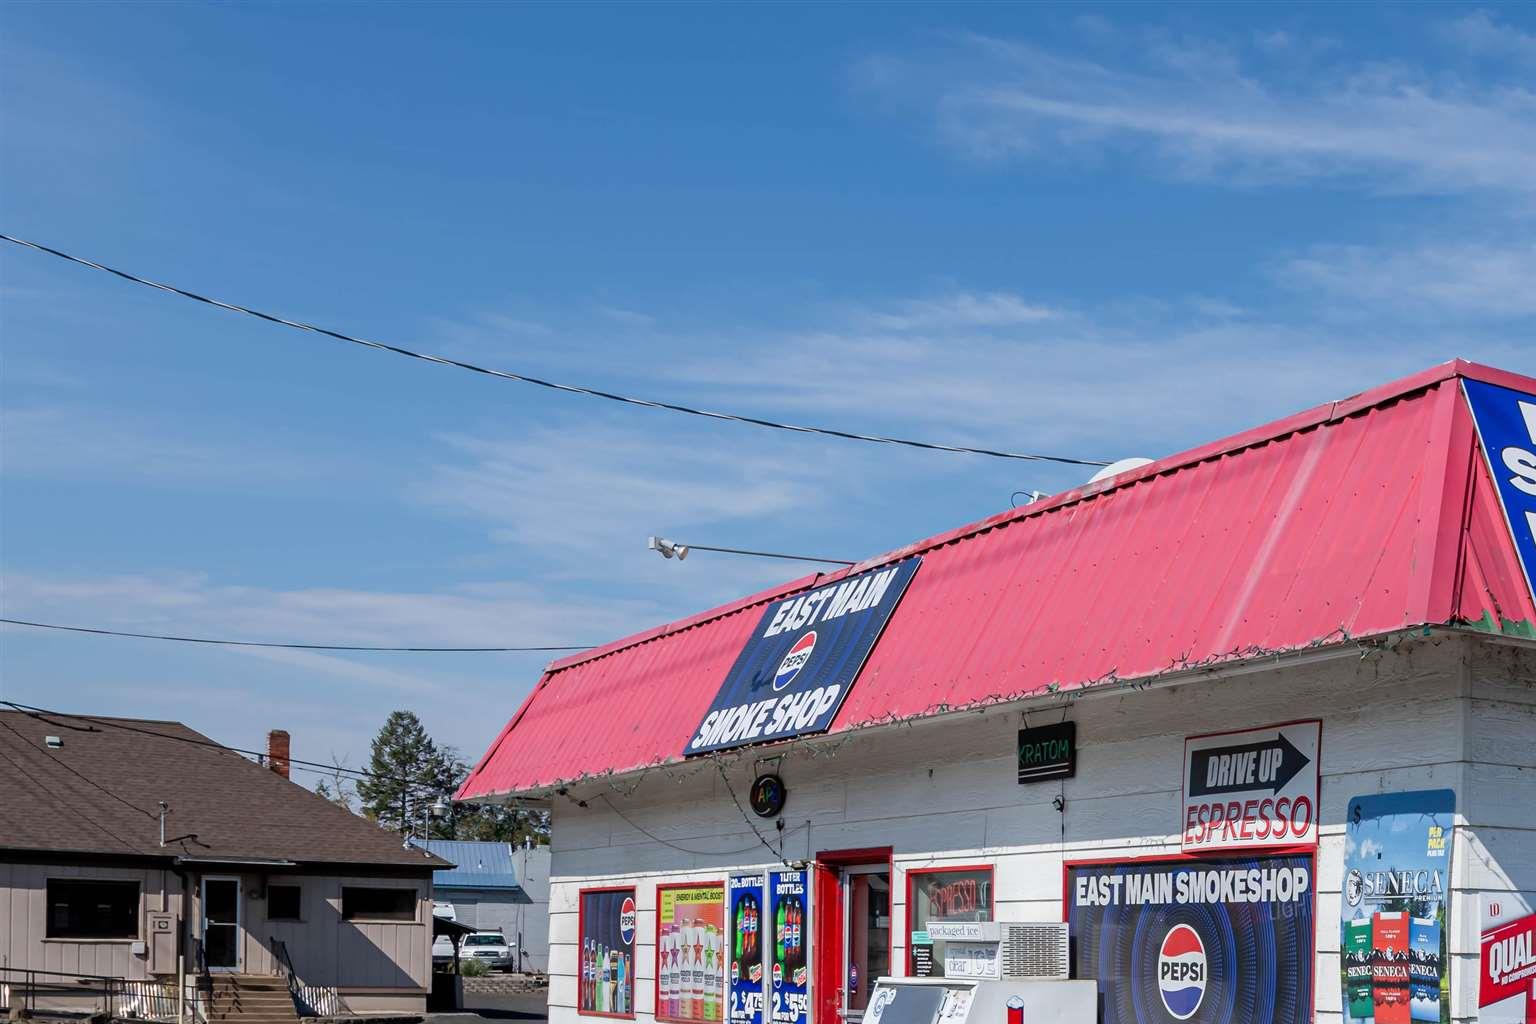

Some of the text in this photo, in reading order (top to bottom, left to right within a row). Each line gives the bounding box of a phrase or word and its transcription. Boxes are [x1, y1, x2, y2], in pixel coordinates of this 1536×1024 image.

[763, 567, 899, 638] EAST MAIN
[783, 652, 808, 670] PEPSI
[691, 684, 841, 749] SMOKE SHOP
[1018, 739, 1070, 766] KRATOM
[1206, 748, 1283, 788] DRIVE UP
[1184, 795, 1312, 845] ESPRESSO
[741, 876, 763, 888] BOTTLES
[783, 872, 801, 882] LITER
[1076, 867, 1309, 907] EAST MAIN SMOKESHOP
[1364, 869, 1442, 896] SENECA
[776, 883, 804, 895] BOTTLES
[929, 925, 967, 938] packaged
[968, 925, 979, 937] ice
[1161, 962, 1204, 982] PEPSI
[1347, 965, 1372, 977] SENEC
[1373, 966, 1407, 977] SENECA
[1409, 964, 1438, 977] ENECA
[731, 991, 738, 1019] 2
[773, 992, 782, 1019] 2
